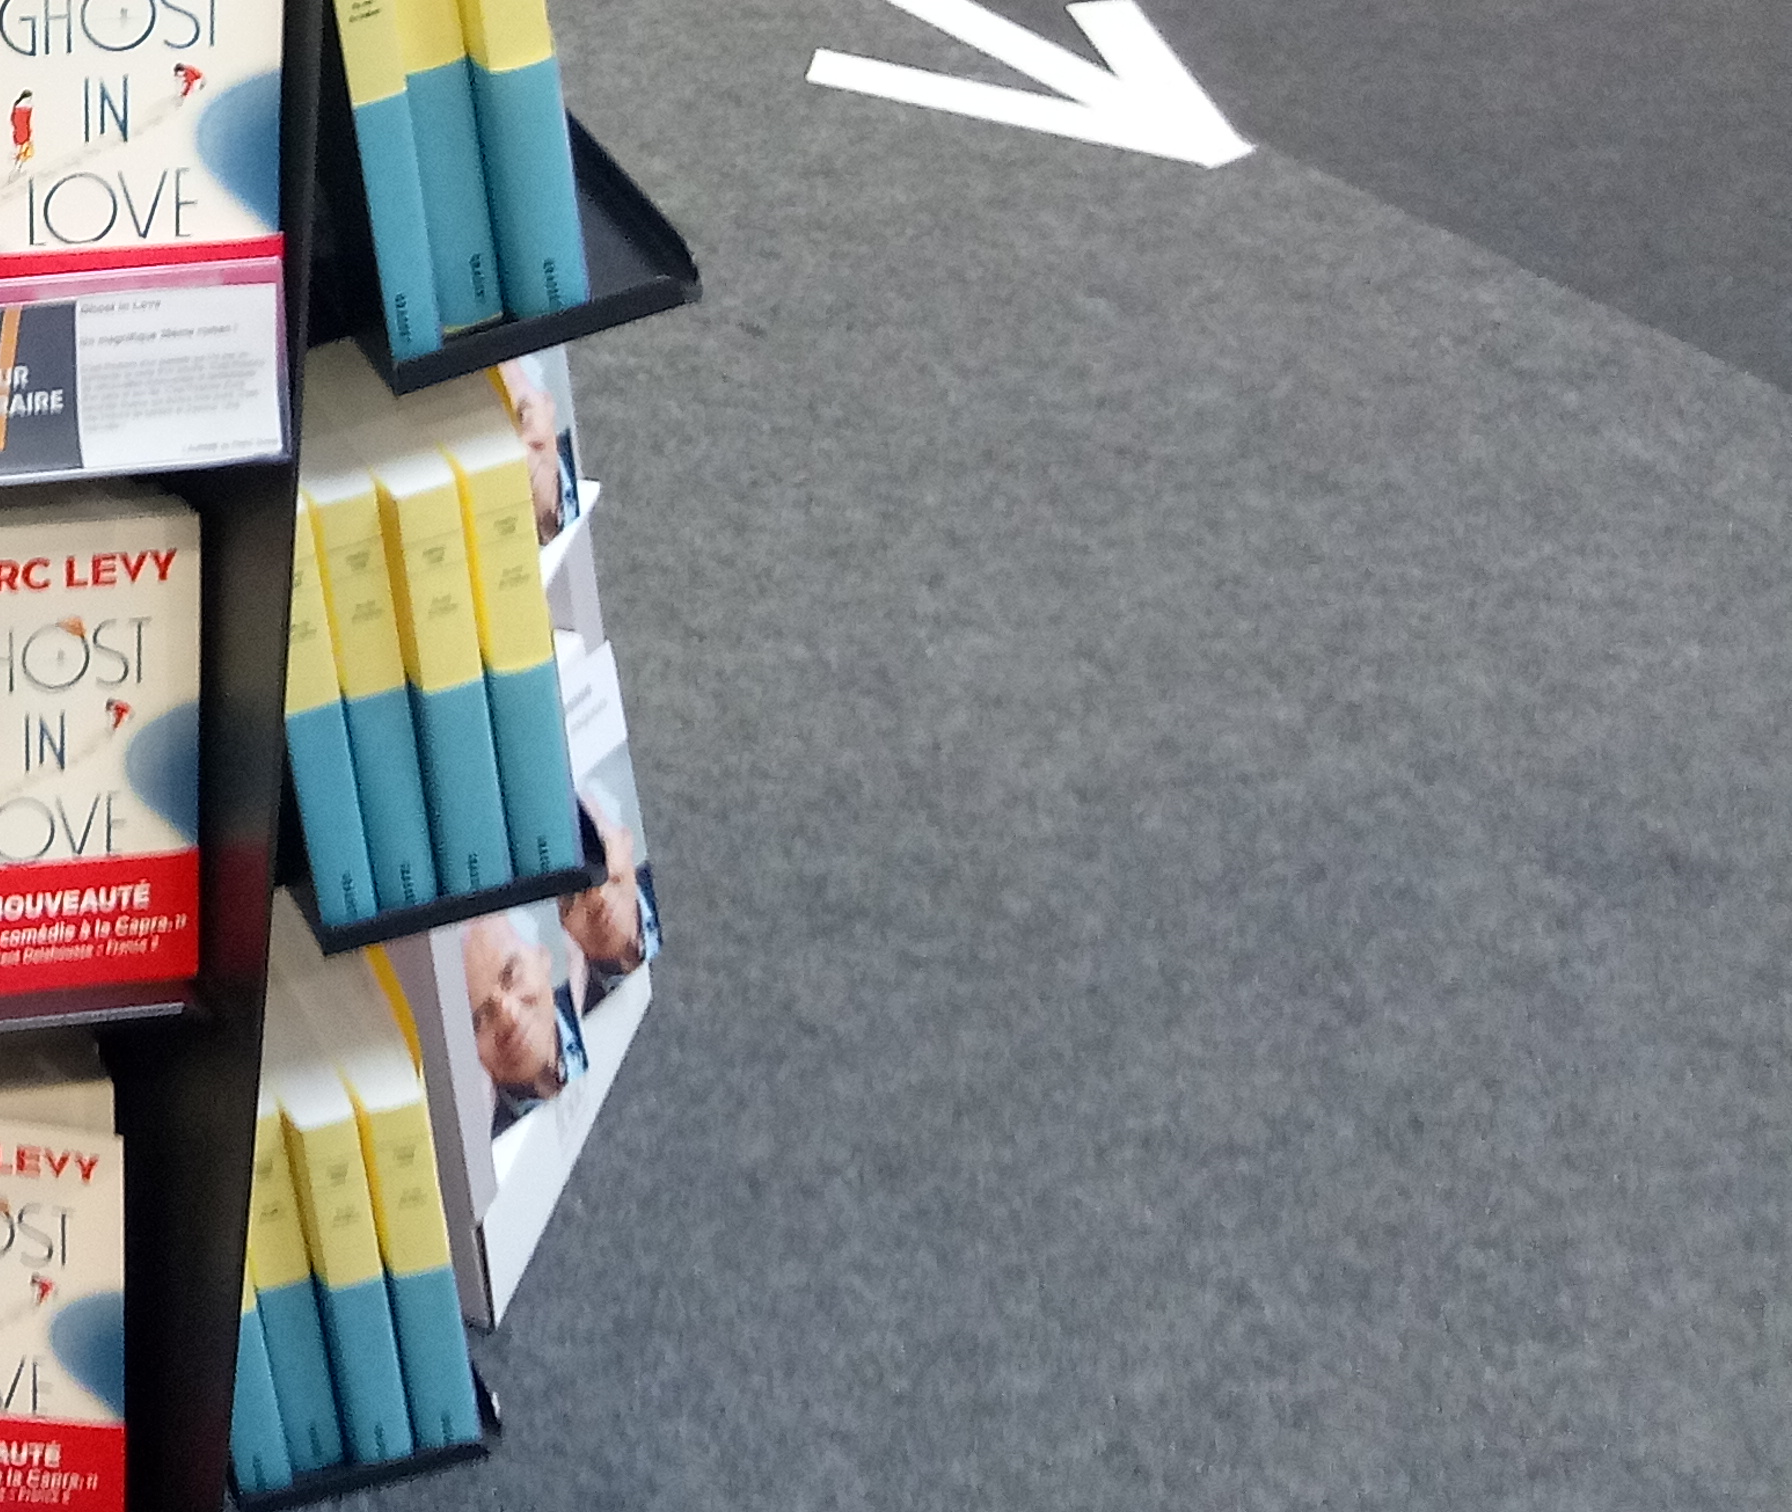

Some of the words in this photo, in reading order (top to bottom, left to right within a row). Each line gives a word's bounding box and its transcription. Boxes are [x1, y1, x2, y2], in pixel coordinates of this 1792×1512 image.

[83, 75, 129, 143] IN
[26, 167, 198, 248] LOVE
[63, 549, 177, 589] LEVY
[23, 709, 66, 772] IN
